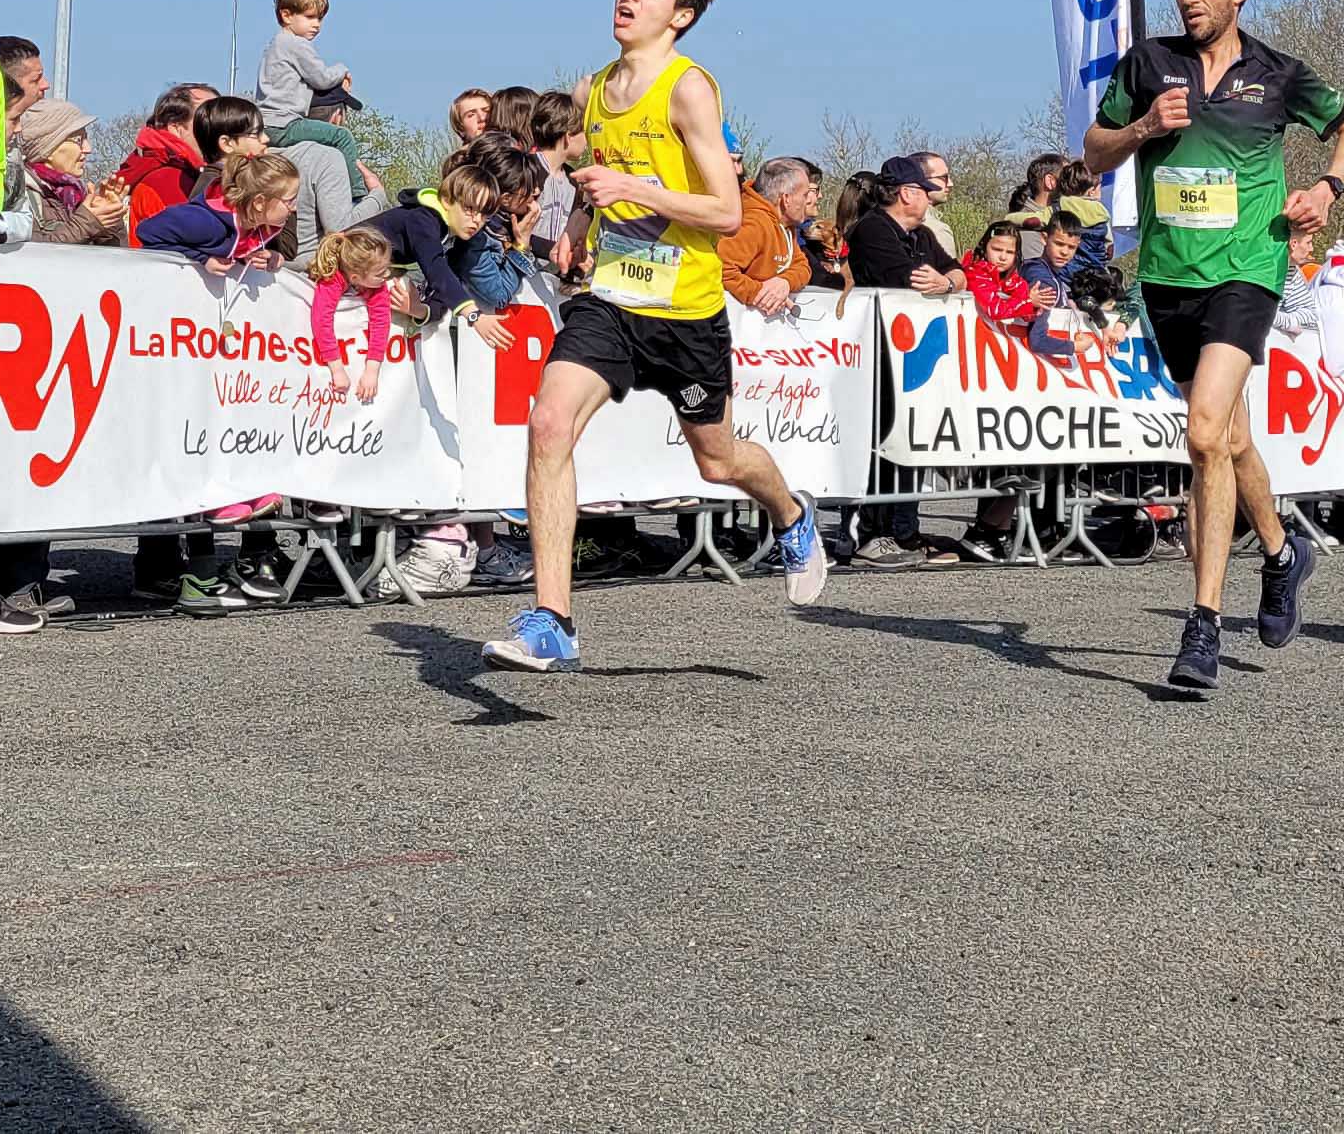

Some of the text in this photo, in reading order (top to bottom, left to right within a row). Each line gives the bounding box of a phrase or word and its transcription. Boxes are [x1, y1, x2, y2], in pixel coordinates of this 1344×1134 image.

[1179, 189, 1208, 204] 964
[619, 261, 654, 283] 1008
[129, 326, 164, 358] La
[215, 369, 262, 408] Ville
[269, 377, 292, 404] et
[744, 374, 821, 419] et Agglo
[183, 419, 208, 456] Le
[292, 415, 384, 458] Vendée
[908, 407, 962, 452] LA
[976, 405, 1123, 452] ROCHE
